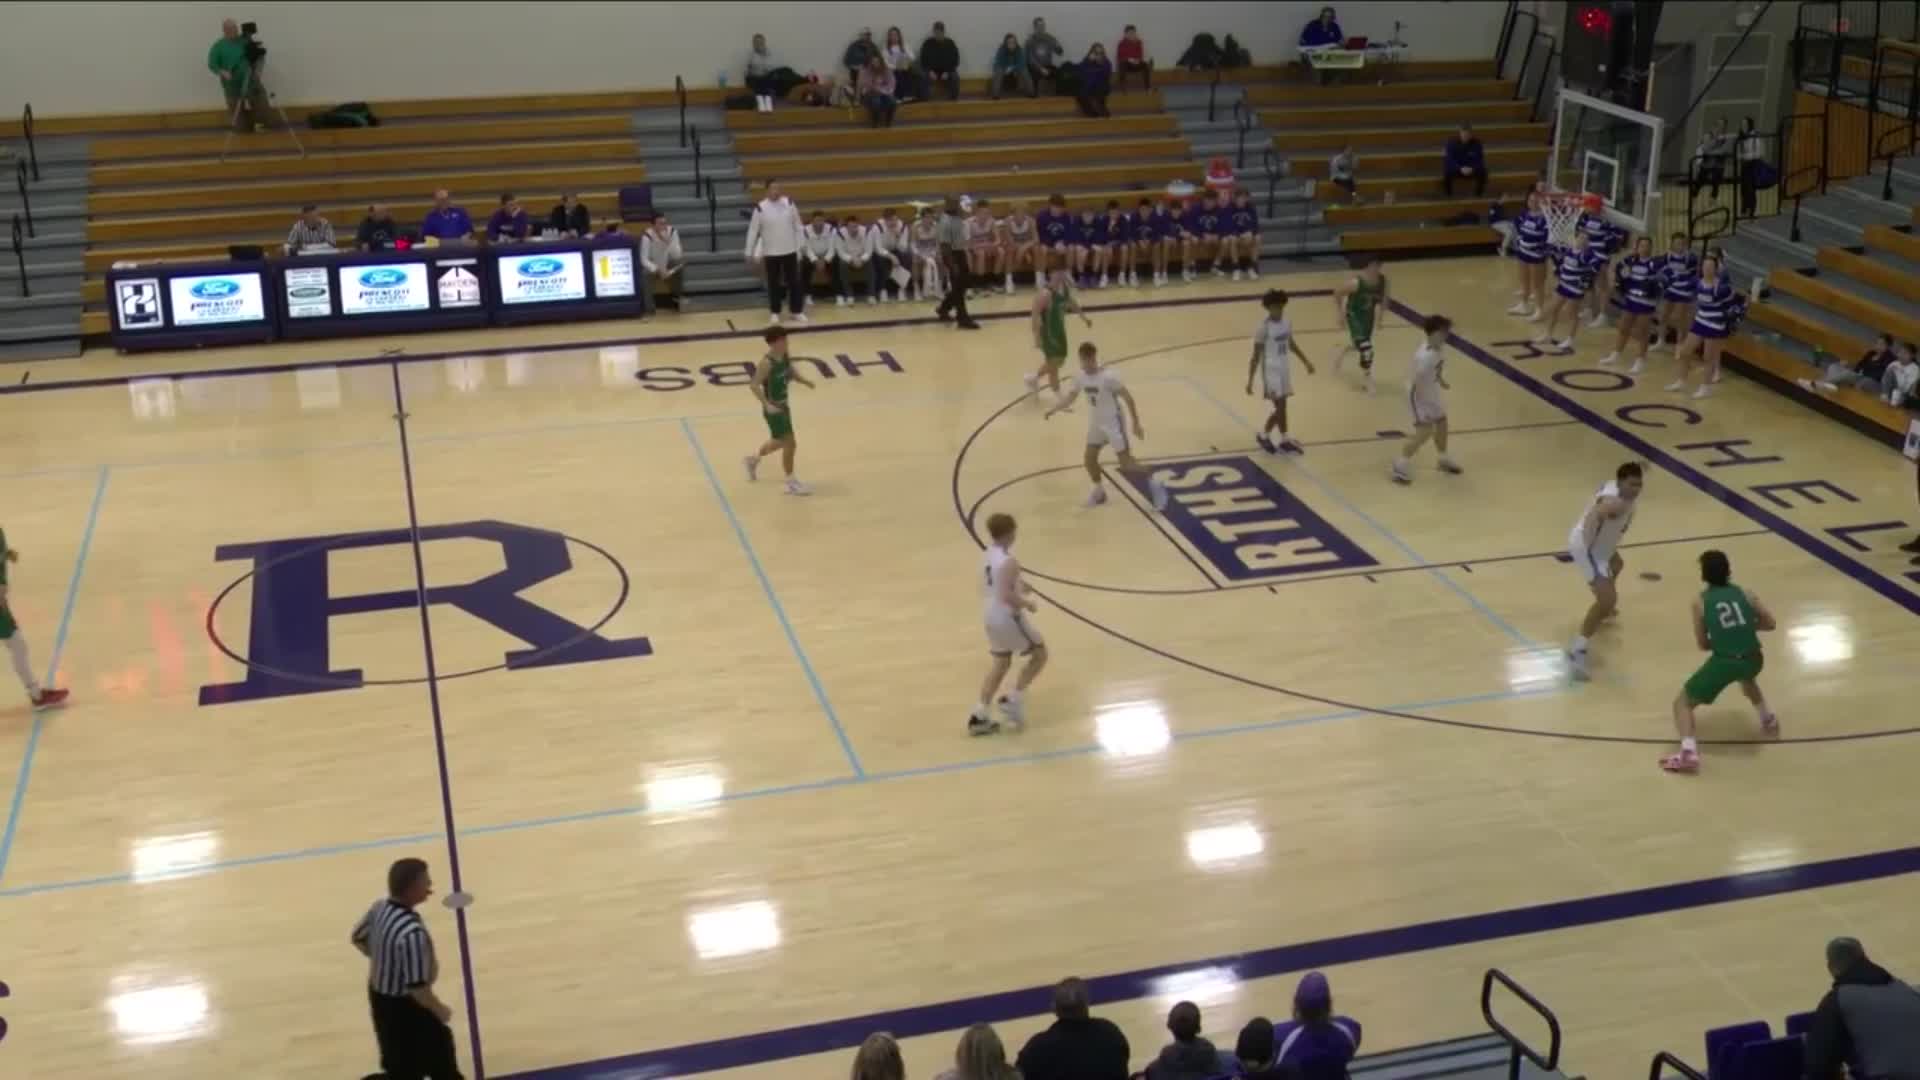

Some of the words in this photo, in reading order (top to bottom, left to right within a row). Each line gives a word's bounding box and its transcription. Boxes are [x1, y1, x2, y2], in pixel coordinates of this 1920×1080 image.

[1149, 464, 1341, 570] RTHS
[1490, 340, 1920, 583] ROCHEL
[199, 519, 654, 707] R
[1715, 600, 1747, 629] 21
